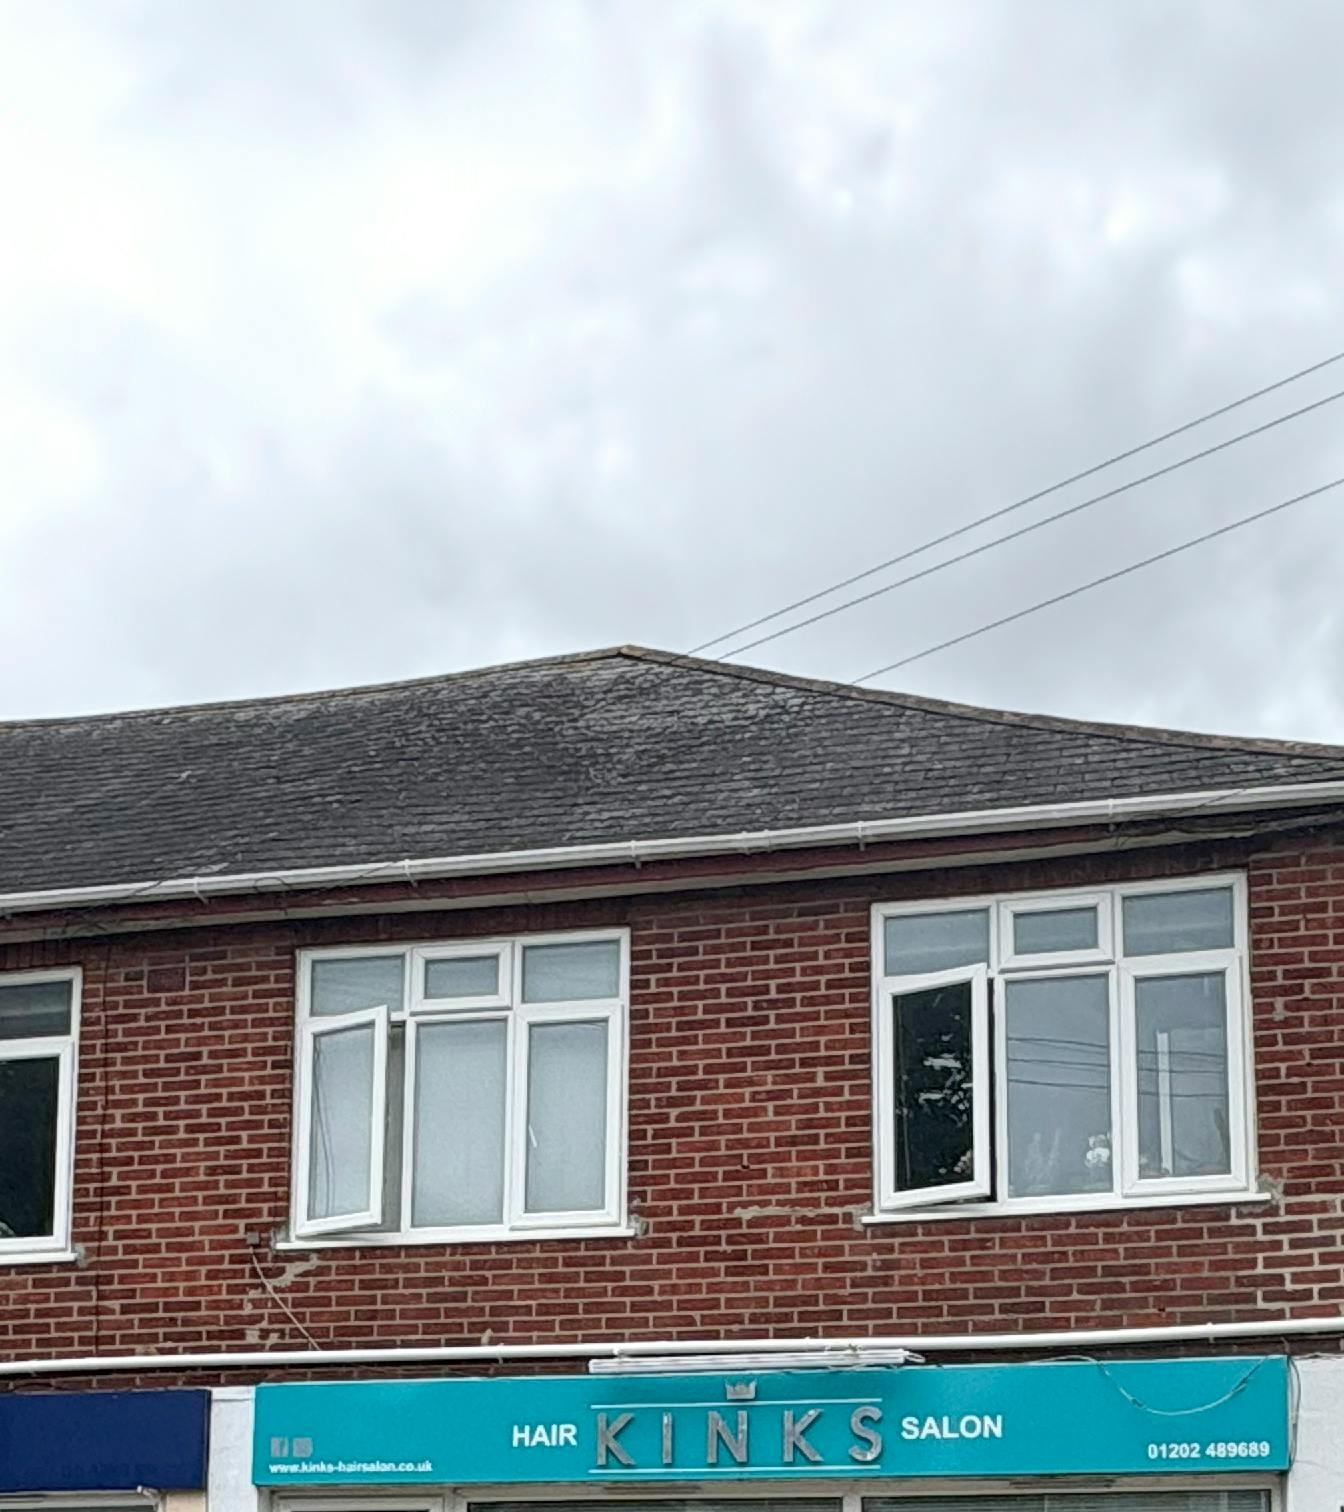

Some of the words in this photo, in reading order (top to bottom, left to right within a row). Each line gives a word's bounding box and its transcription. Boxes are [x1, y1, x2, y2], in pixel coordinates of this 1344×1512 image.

[511, 1424, 578, 1448] HAIR
[595, 1406, 884, 1466] KINKS
[901, 1414, 1003, 1441] SALON
[1147, 1442, 1201, 1459] 01202
[1205, 1441, 1270, 1458] 489689
[268, 1459, 433, 1474] www.kinks-hairsalon.co.uk
